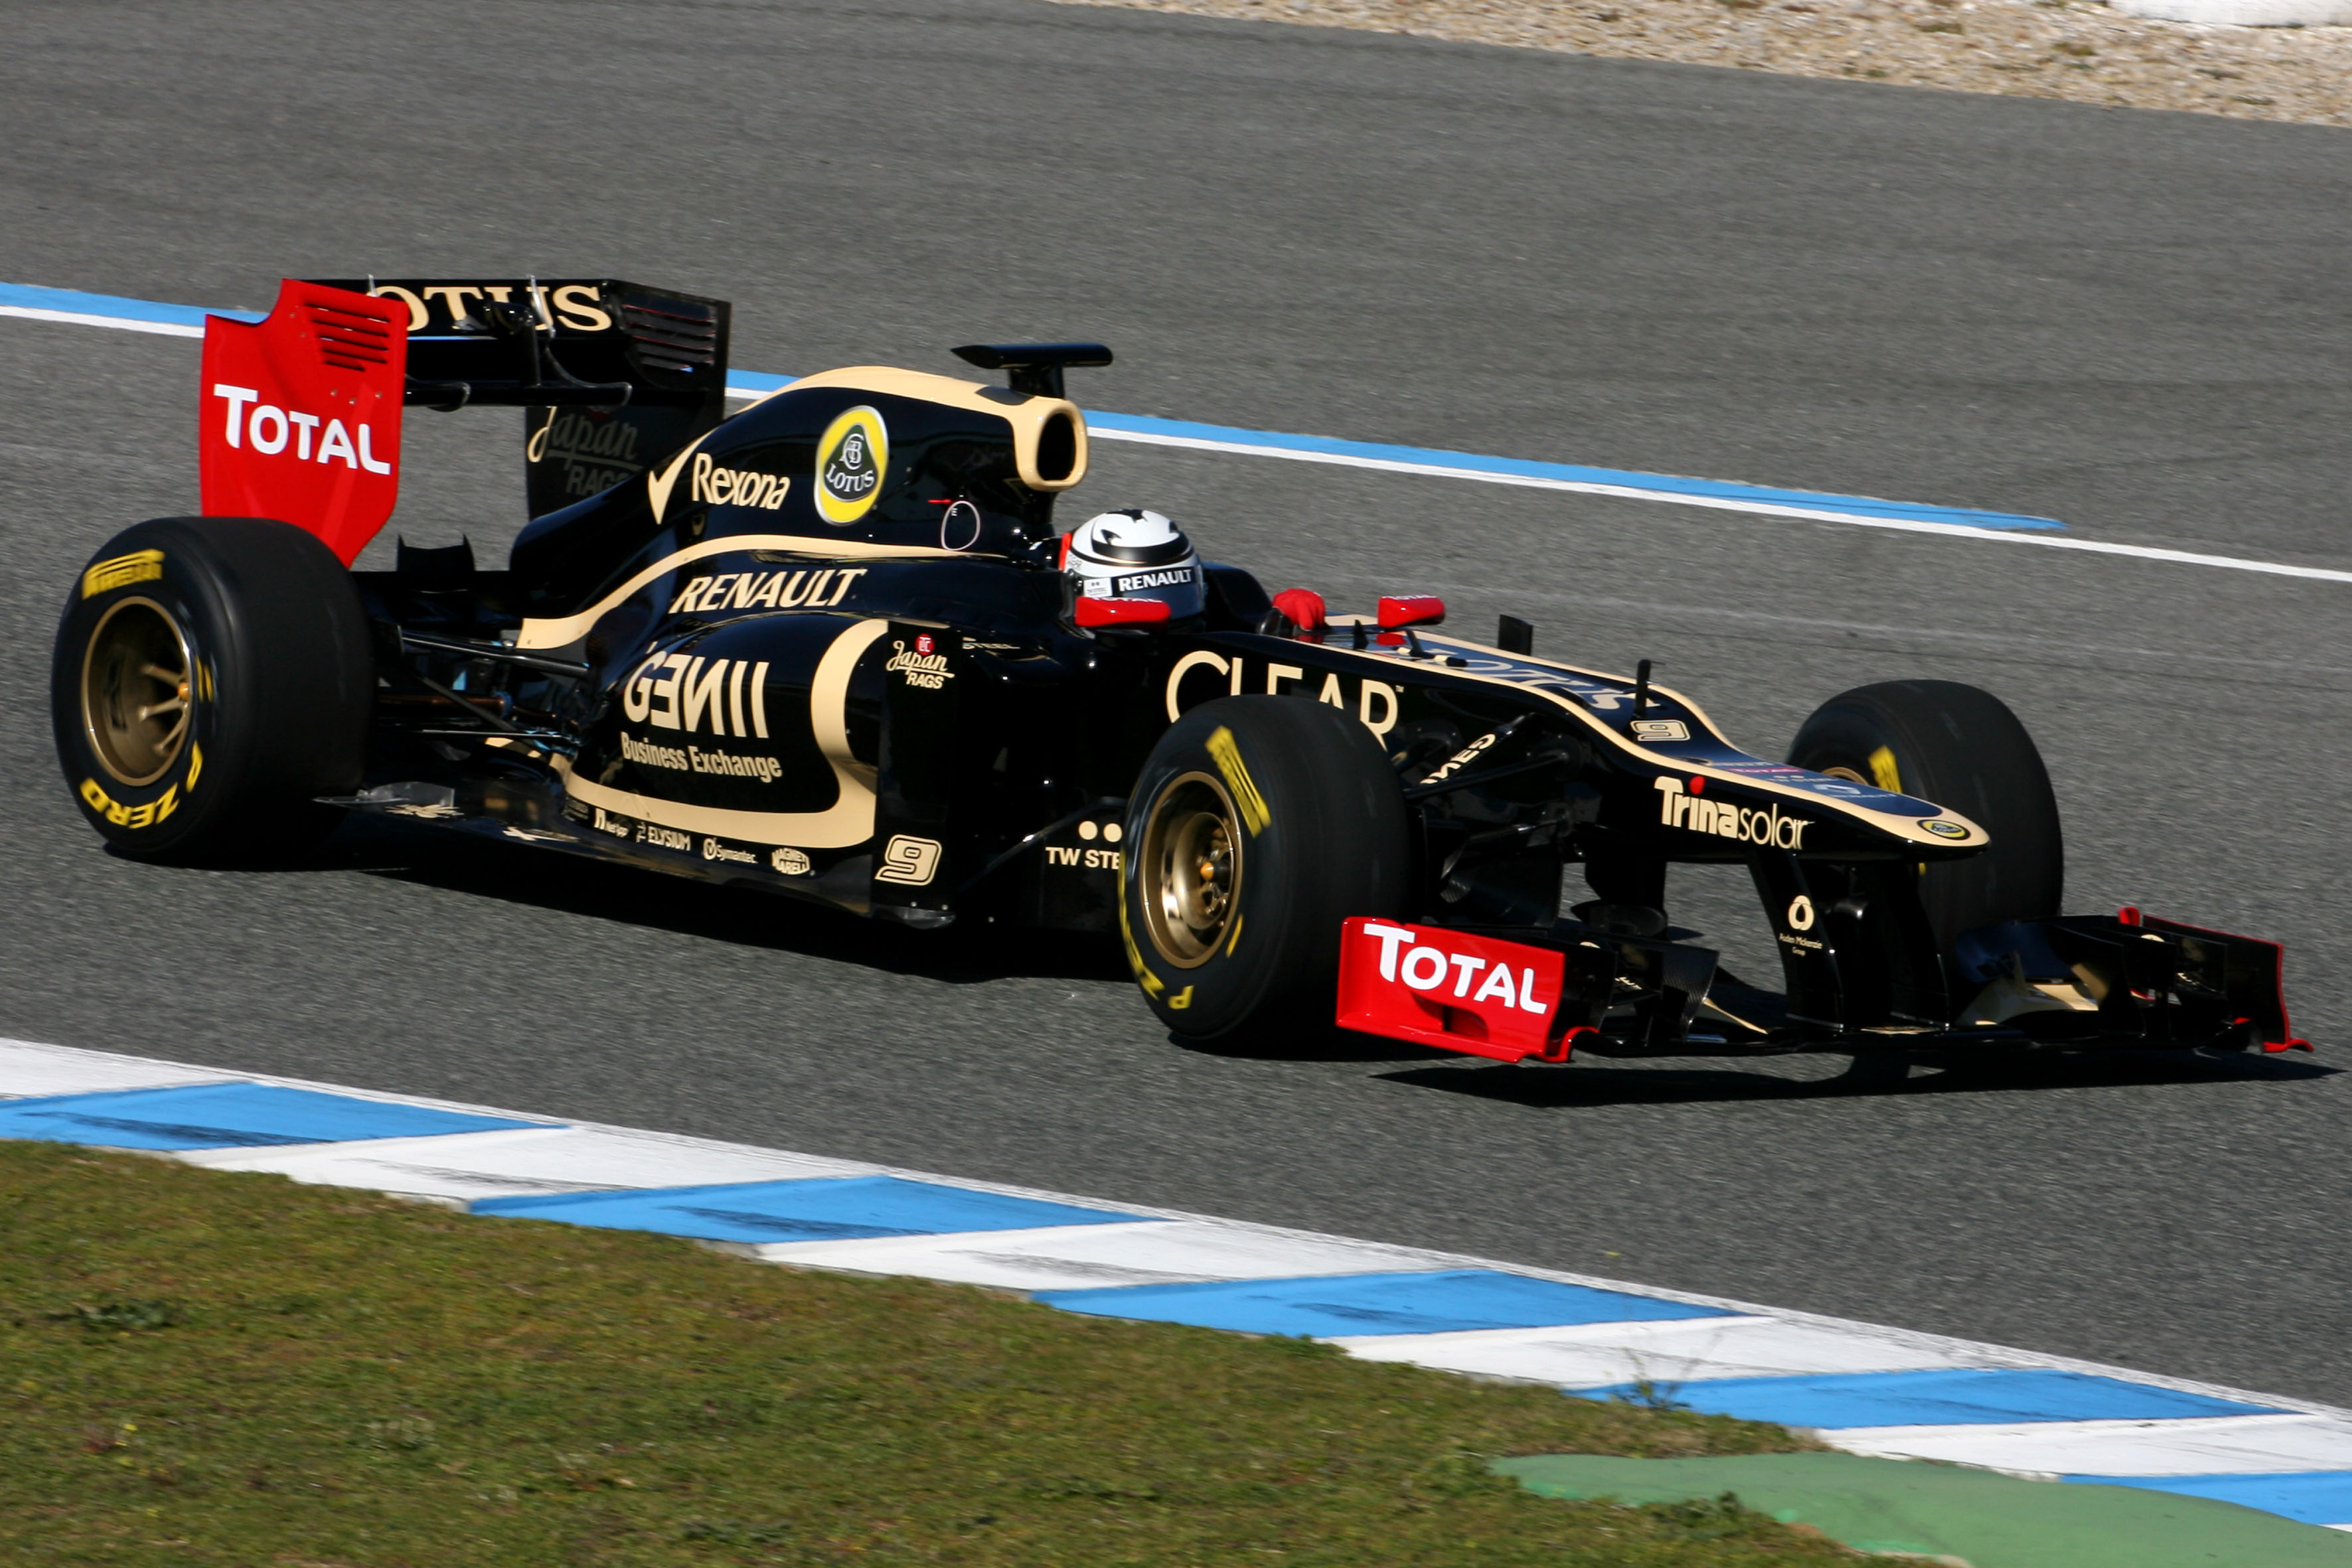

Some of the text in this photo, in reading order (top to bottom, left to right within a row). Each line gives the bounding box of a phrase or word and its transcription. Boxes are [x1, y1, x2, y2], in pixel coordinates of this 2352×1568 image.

[366, 285, 612, 331] OTUS
[213, 383, 391, 475] TOTAL
[692, 452, 791, 510] Rexona
[825, 463, 874, 493] LOTUS
[668, 568, 868, 614] RENAULT
[1118, 568, 1192, 591] RENAULT
[886, 641, 948, 675] Japan
[906, 672, 944, 689] RAGS
[1630, 720, 1691, 742] 9
[621, 732, 783, 783] Business Exchange
[1420, 734, 1496, 784] GENI
[80, 778, 179, 828] ZERO
[874, 834, 942, 886] 9
[1046, 846, 1120, 870] TW STE
[1363, 923, 1547, 1014] TOTAL
